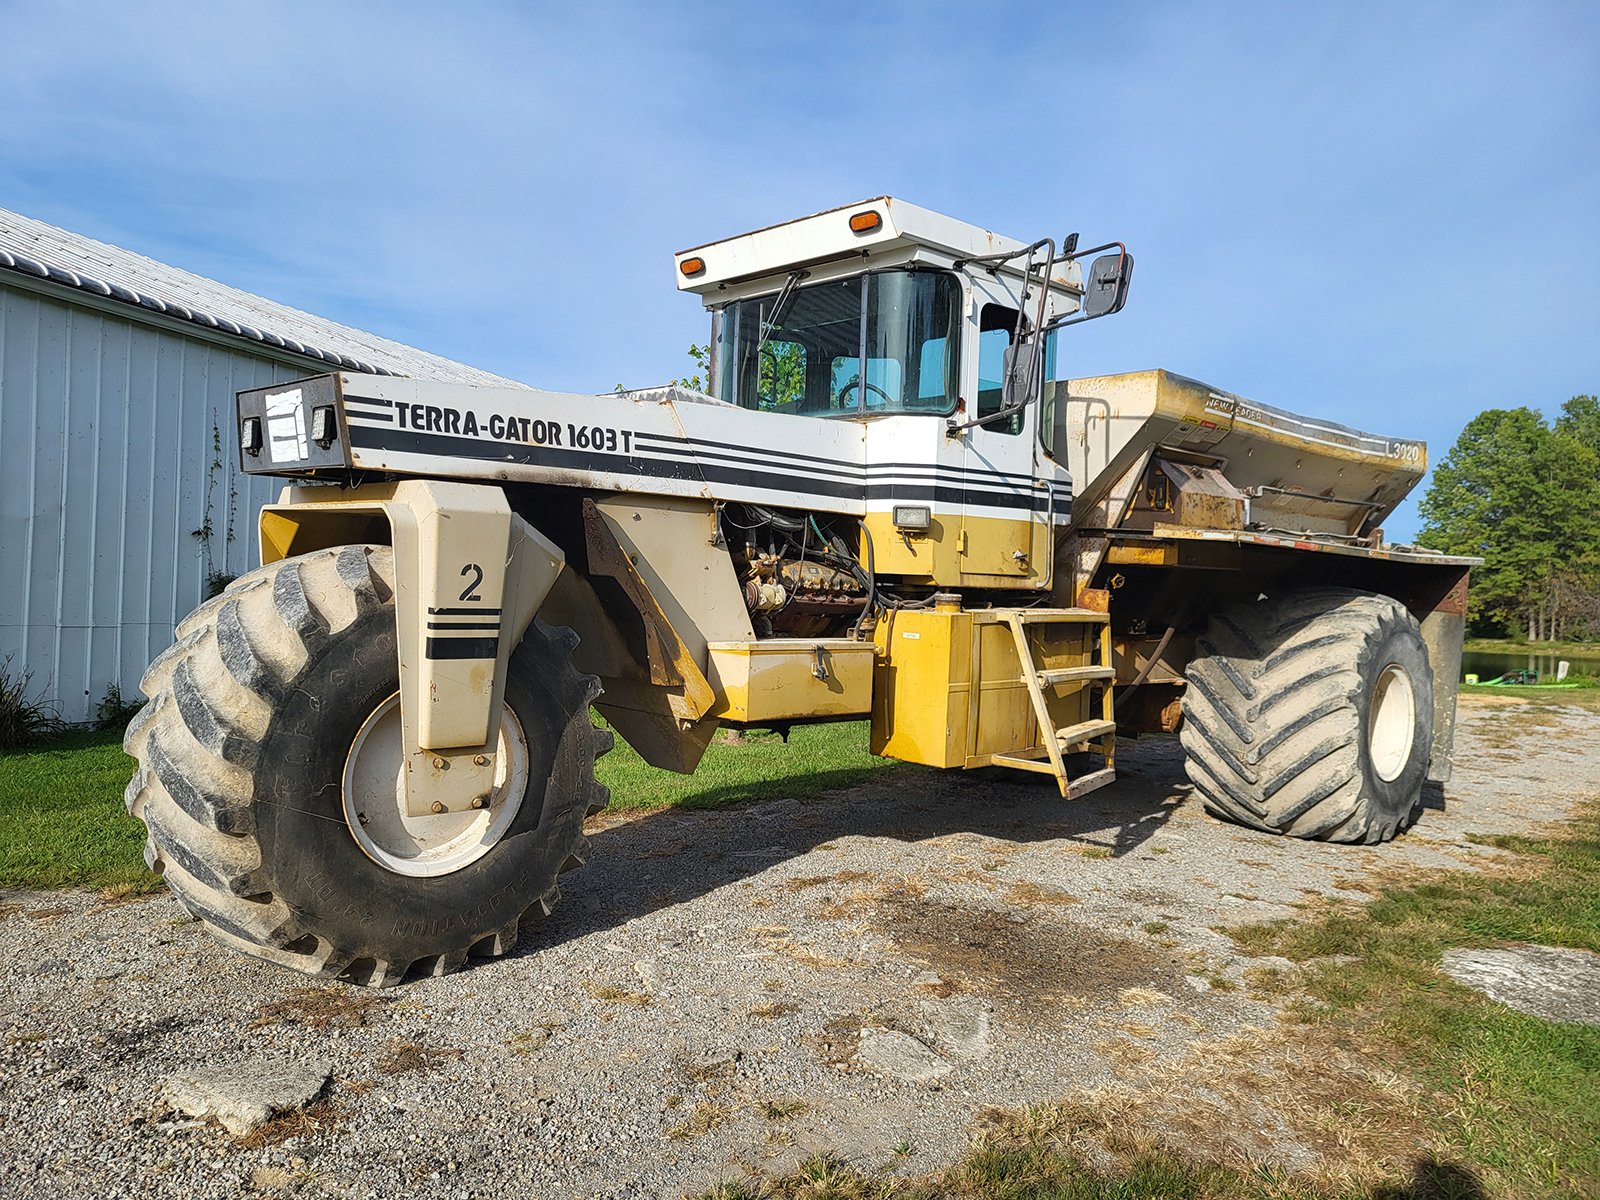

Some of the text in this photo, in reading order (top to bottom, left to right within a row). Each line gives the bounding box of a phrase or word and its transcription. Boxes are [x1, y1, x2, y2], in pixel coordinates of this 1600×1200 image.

[1205, 398, 1229, 410] NEW
[395, 401, 562, 446] TERRA-GATOR
[1385, 440, 1420, 461] L3020
[458, 563, 484, 602] 2
